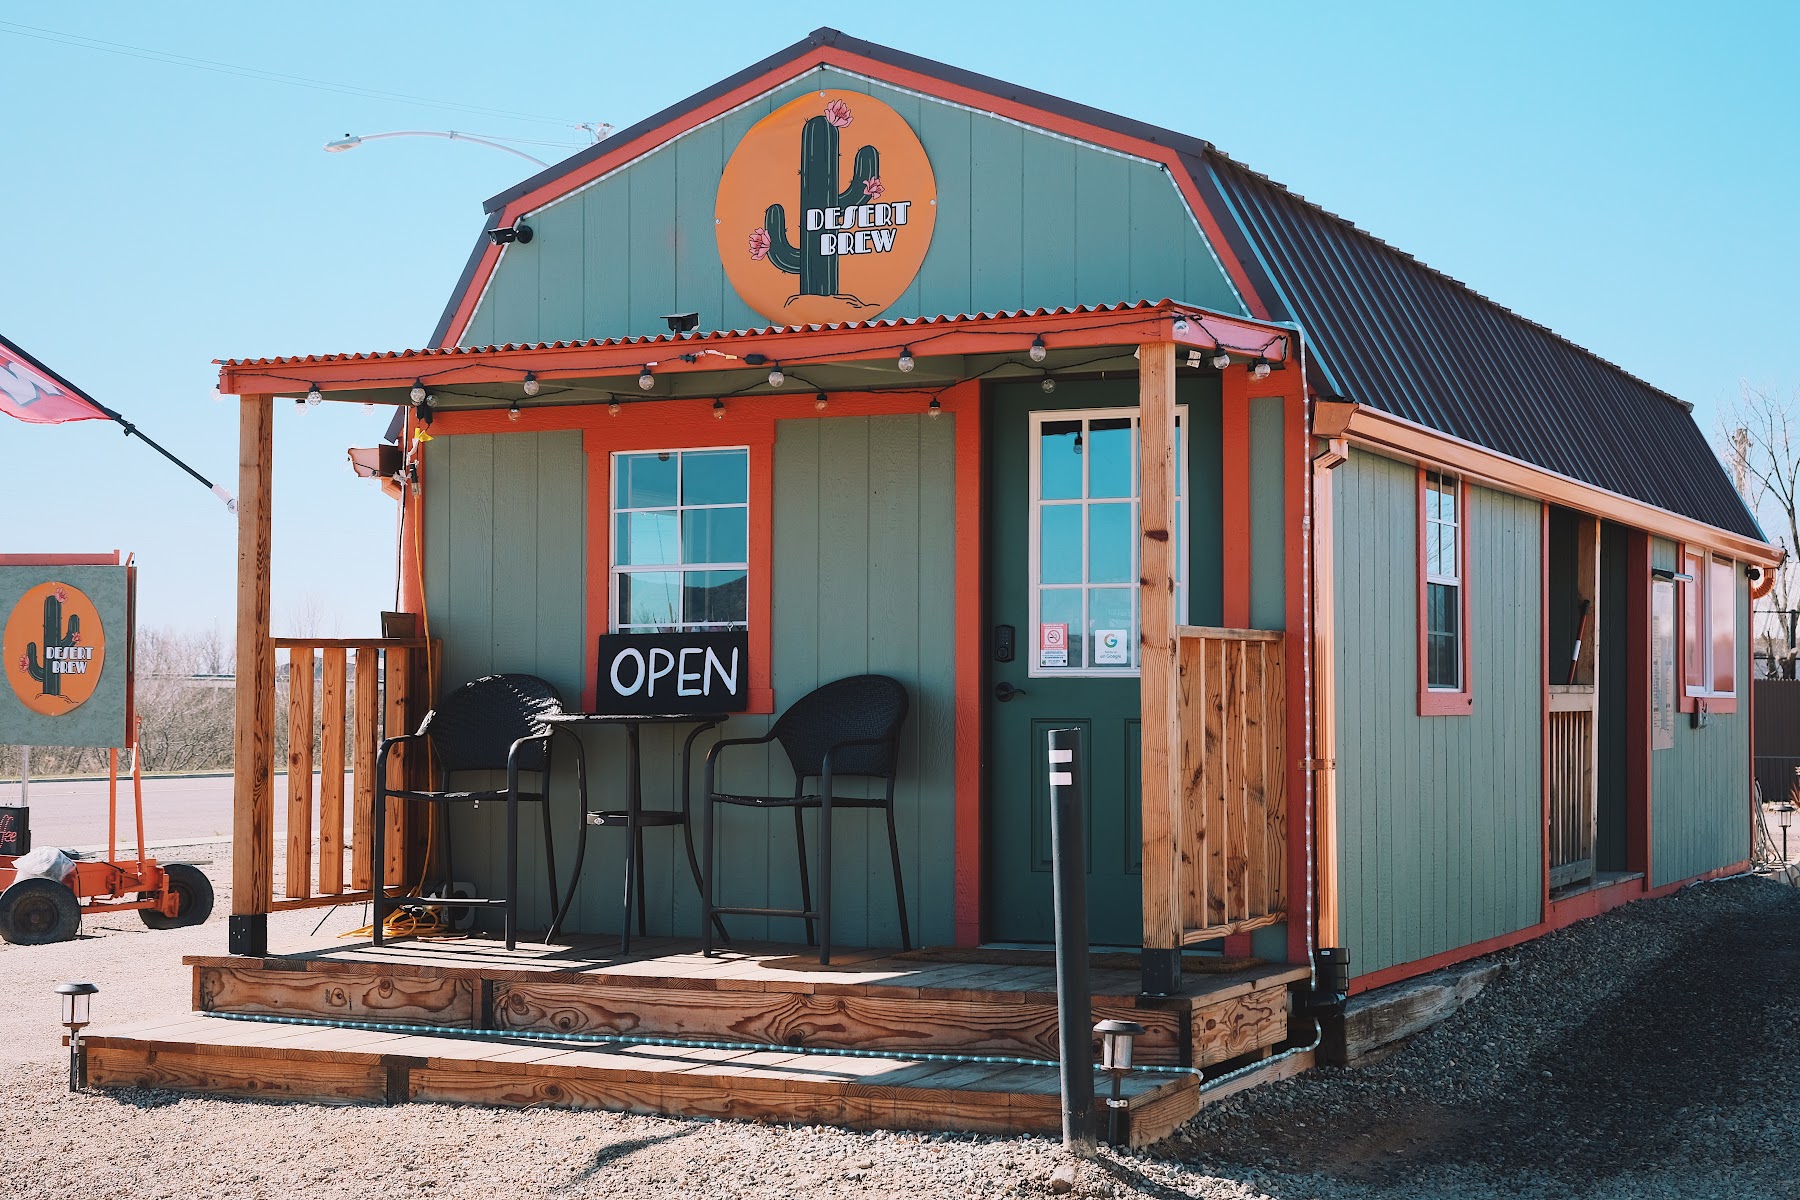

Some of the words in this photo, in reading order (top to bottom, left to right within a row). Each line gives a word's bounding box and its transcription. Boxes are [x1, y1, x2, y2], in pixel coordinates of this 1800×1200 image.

[806, 201, 911, 232] DESERT
[820, 228, 897, 256] BREW
[45, 646, 94, 661] DESERT
[52, 660, 88, 674] BREW
[610, 646, 739, 698] OPEN
